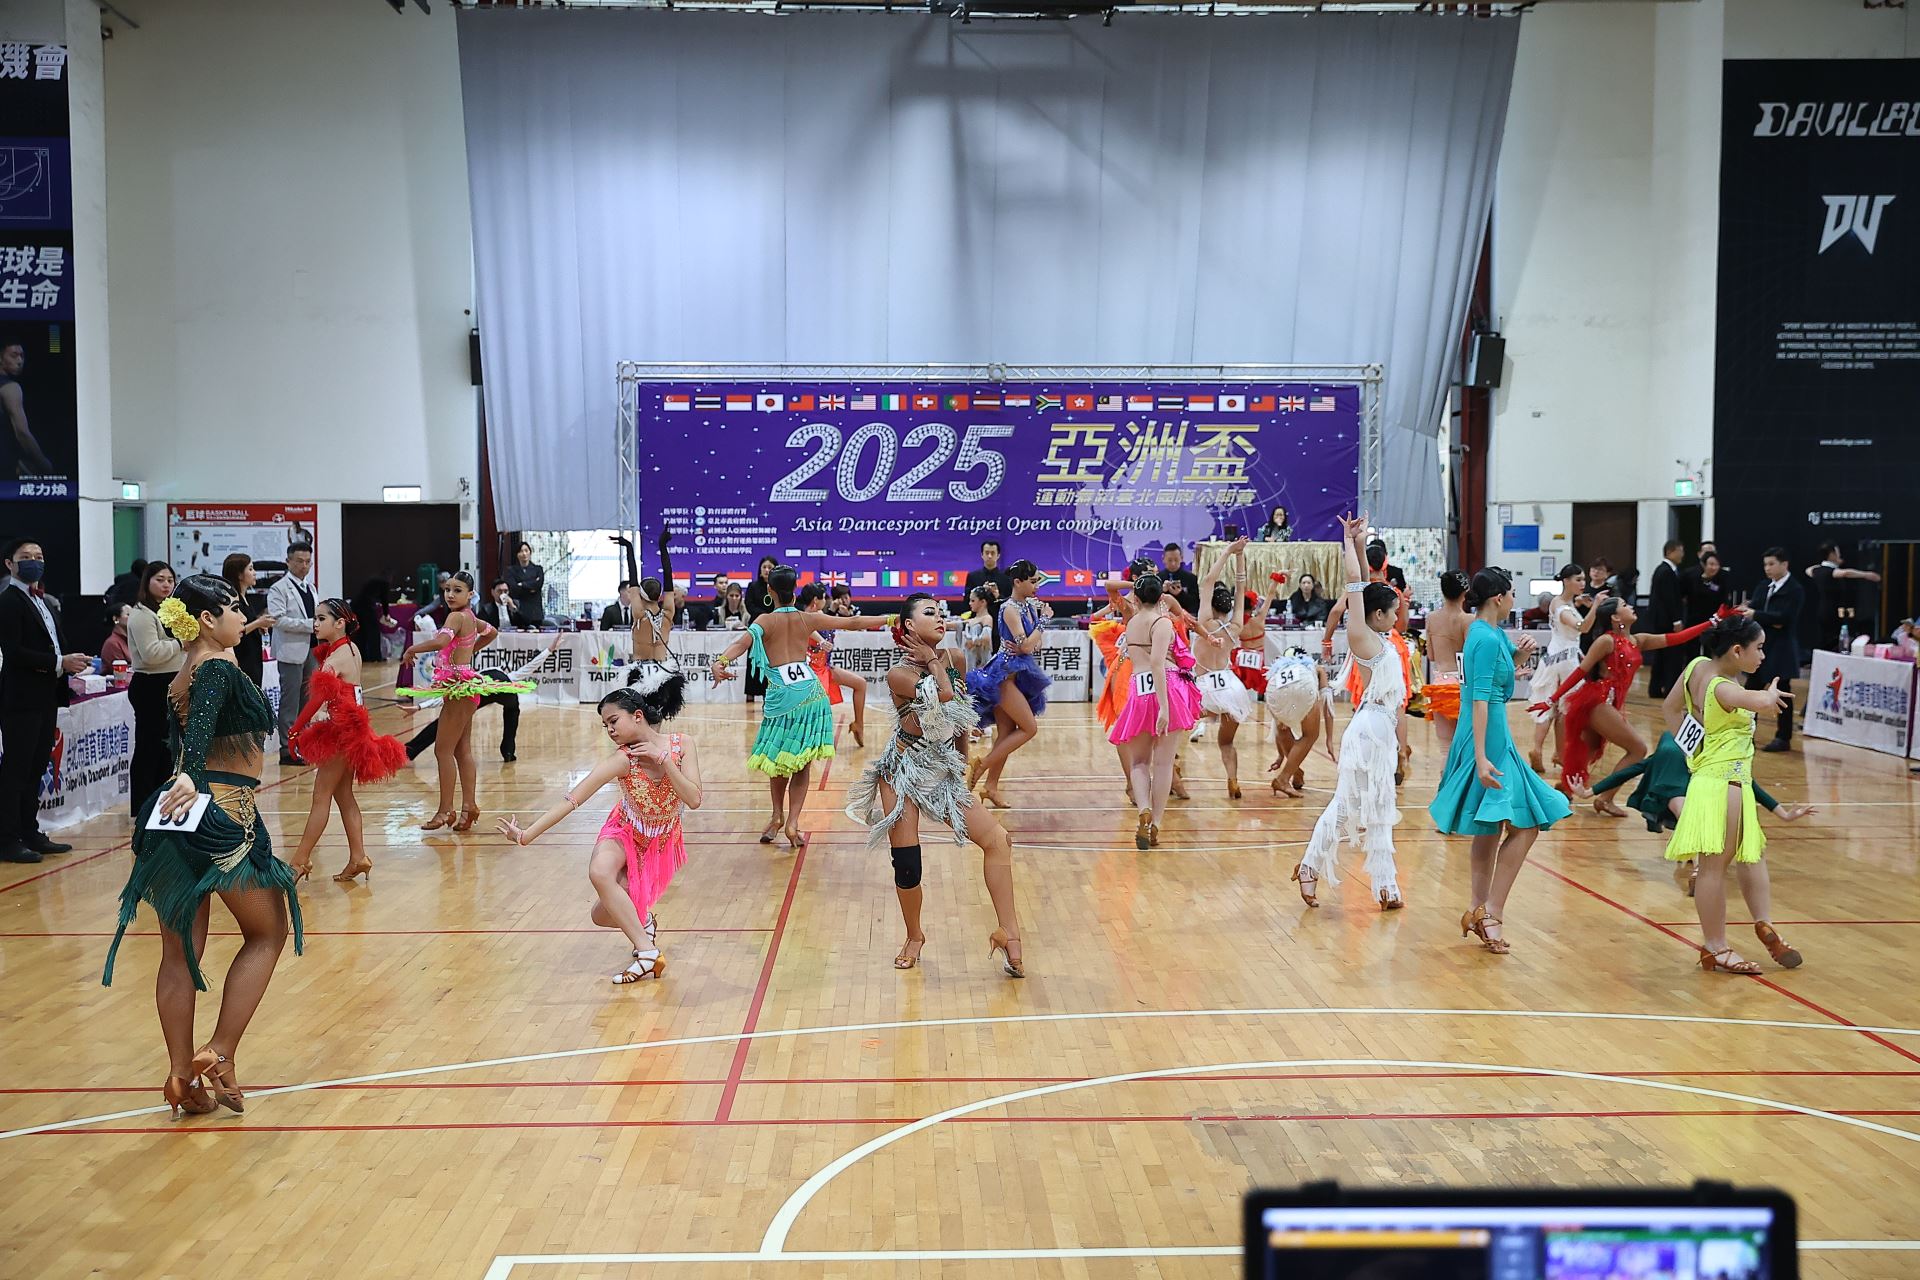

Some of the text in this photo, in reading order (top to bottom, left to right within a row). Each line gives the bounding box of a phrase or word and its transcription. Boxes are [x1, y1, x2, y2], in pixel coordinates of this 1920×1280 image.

[0, 246, 64, 277] 球是
[0, 280, 60, 310] 生命
[1036, 420, 1260, 484] 亞洲盃
[769, 422, 1015, 502] 2025
[791, 516, 1162, 537] Asia Dancesport Taipei Open competition
[1242, 653, 1257, 666] 141
[588, 672, 619, 681] TAIP
[687, 671, 699, 681] to
[788, 664, 805, 681] 64
[1210, 673, 1226, 689] 76
[1280, 670, 1294, 684] 54
[1679, 719, 1702, 751] 198
